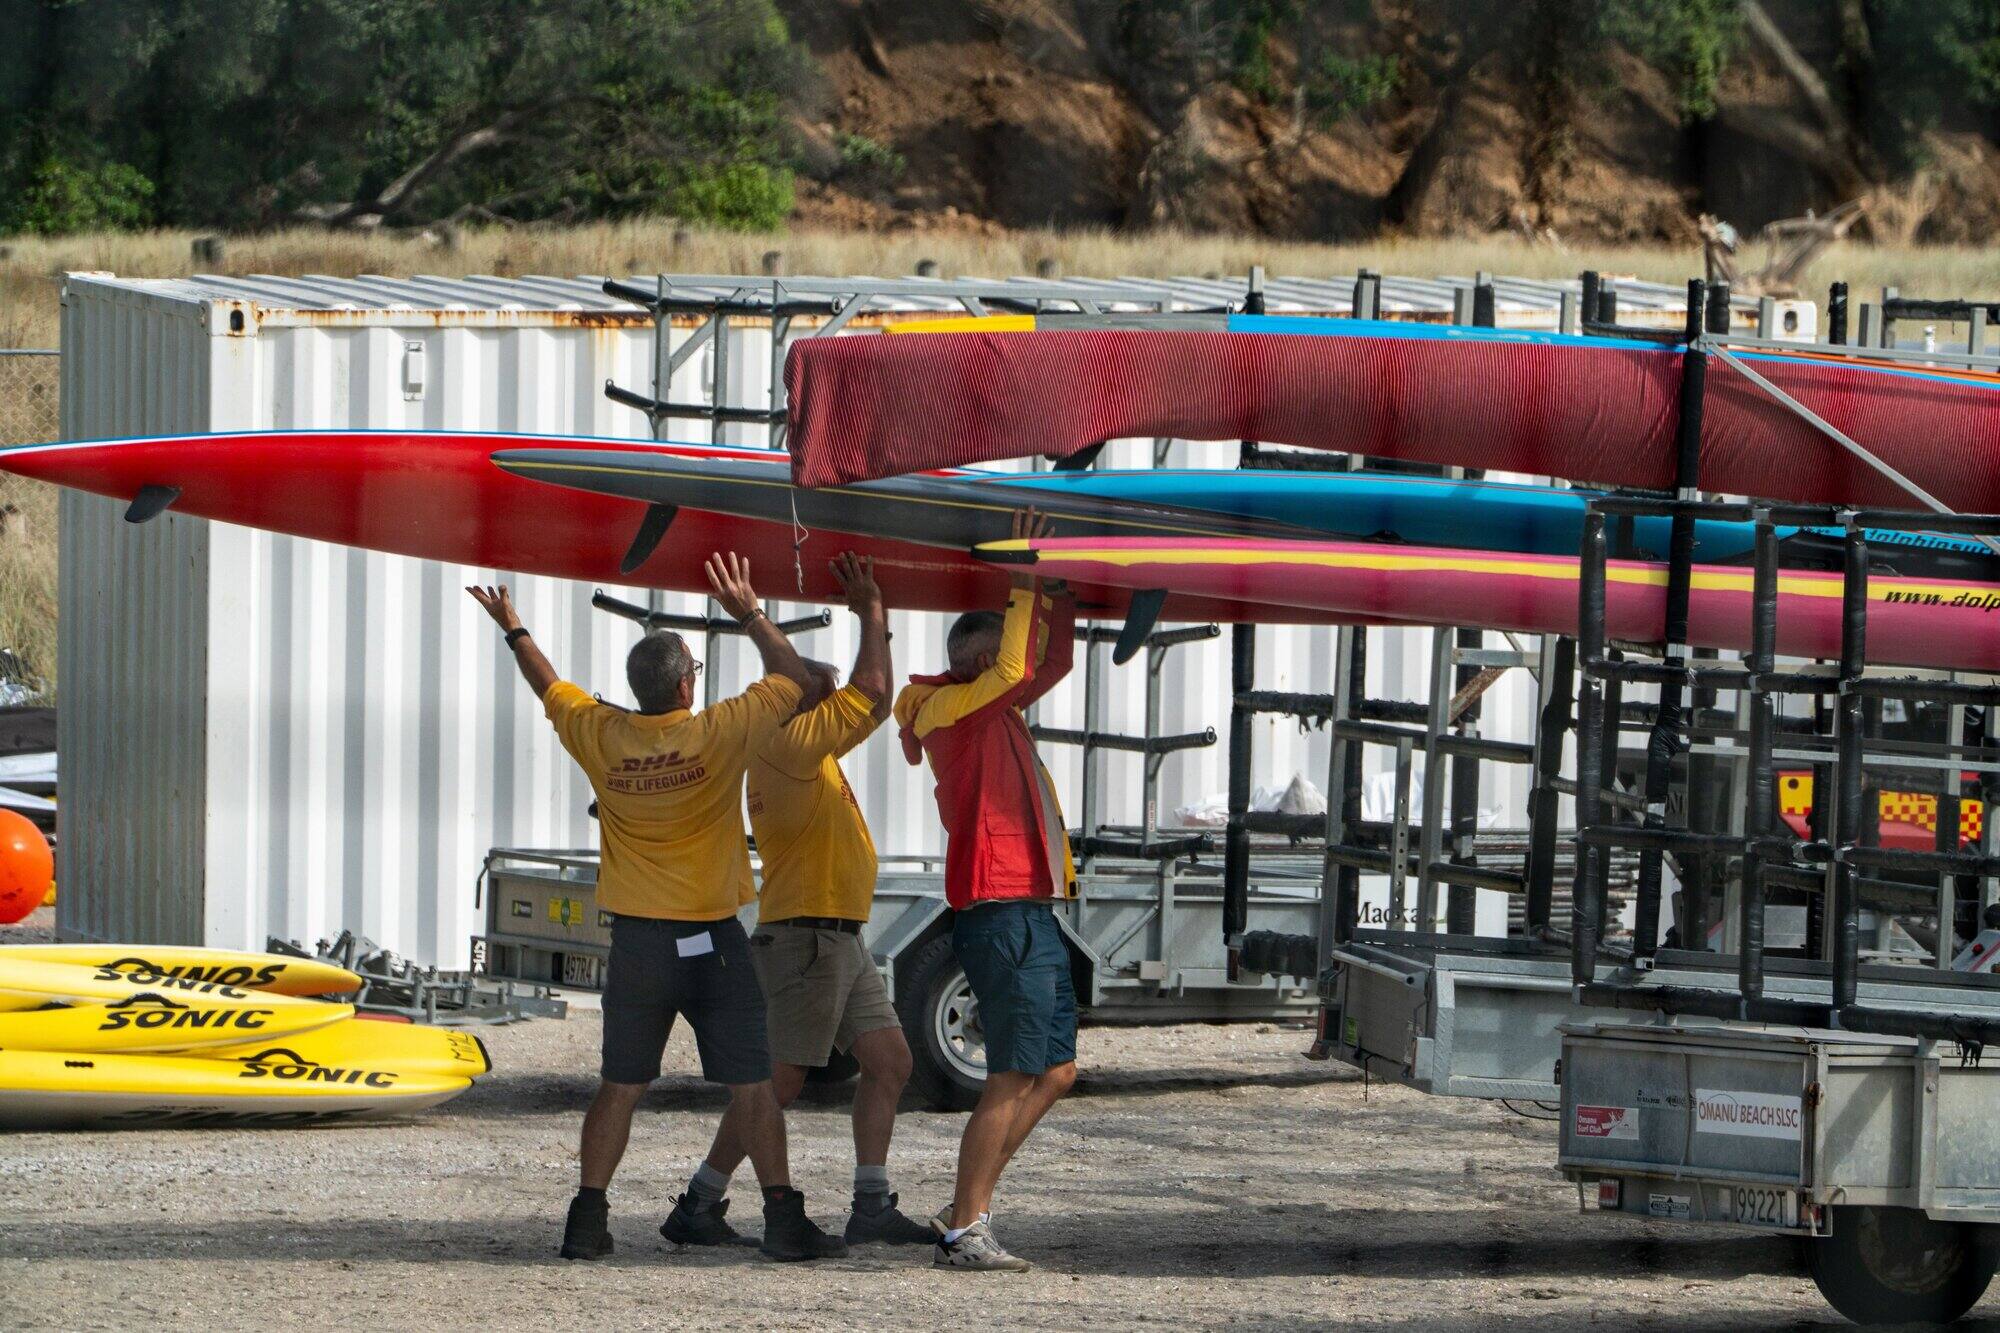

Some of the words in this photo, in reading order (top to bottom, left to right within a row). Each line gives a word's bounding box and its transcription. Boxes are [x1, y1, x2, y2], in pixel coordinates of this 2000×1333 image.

[622, 750, 686, 772] DHL
[636, 766, 706, 791] LIFEGUARD
[98, 1010, 276, 1031] SONIC
[239, 1062, 399, 1089] SONIC
[1698, 1101, 1739, 1123] OMANU
[1740, 1105, 1774, 1126] BEACH
[1776, 1107, 1798, 1128] SLSC
[1737, 1187, 1787, 1225] 9922T
